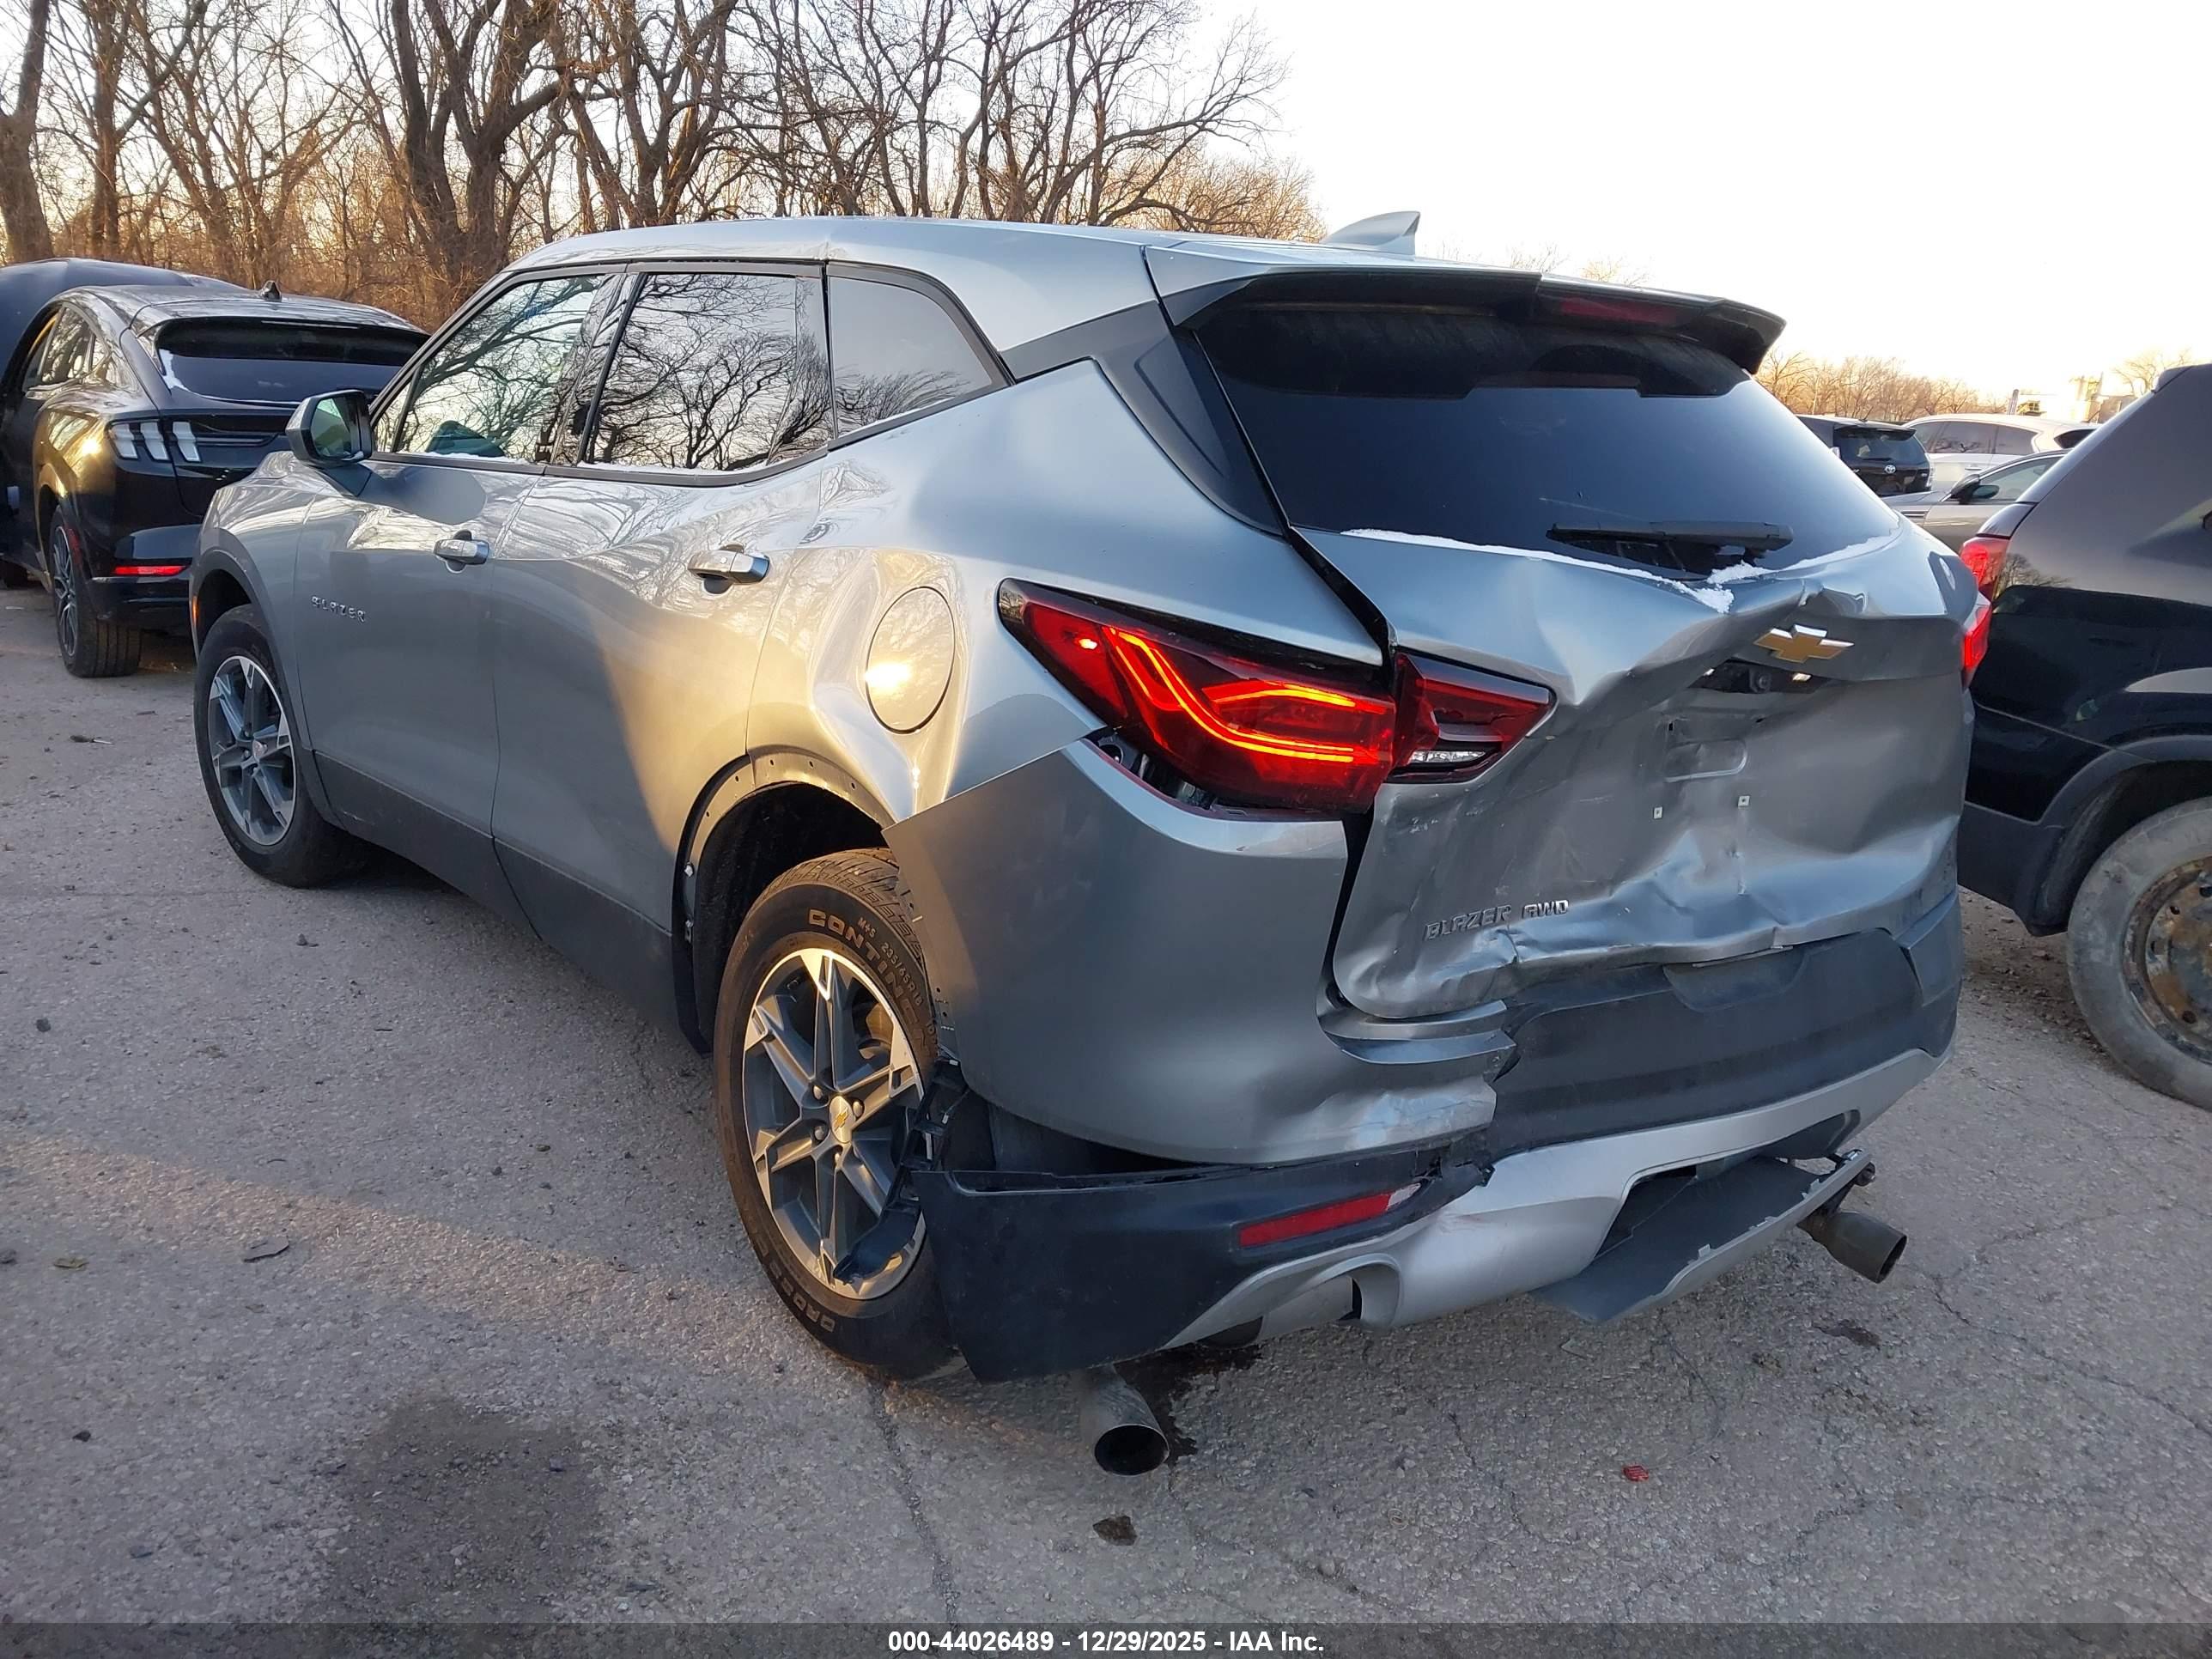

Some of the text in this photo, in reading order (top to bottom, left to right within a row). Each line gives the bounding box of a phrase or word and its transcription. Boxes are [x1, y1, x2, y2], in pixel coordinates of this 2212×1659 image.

[311, 595, 367, 623] BLAZER
[858, 916, 877, 939] M+S
[1425, 899, 1570, 941] BLAZER AWD
